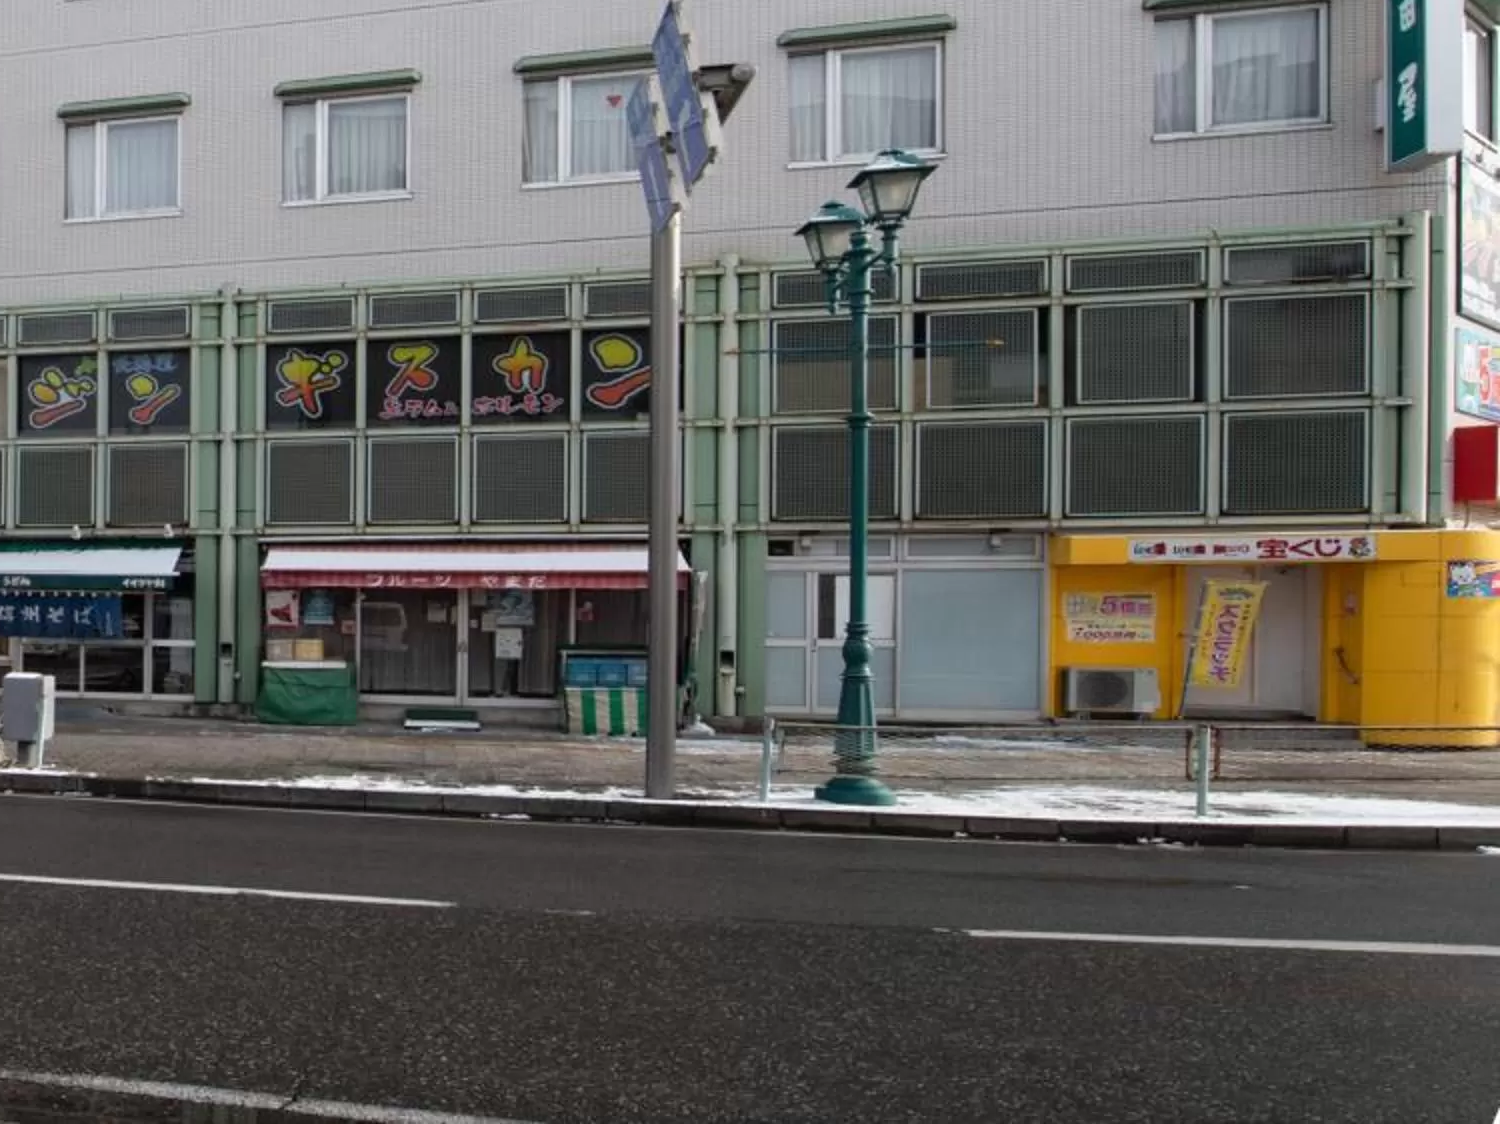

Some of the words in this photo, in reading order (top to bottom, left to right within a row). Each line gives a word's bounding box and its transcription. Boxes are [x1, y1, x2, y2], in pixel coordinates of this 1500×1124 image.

[1255, 537, 1343, 560] 宝くじ
[365, 573, 452, 588] フルーツ
[481, 574, 548, 589] やまだ
